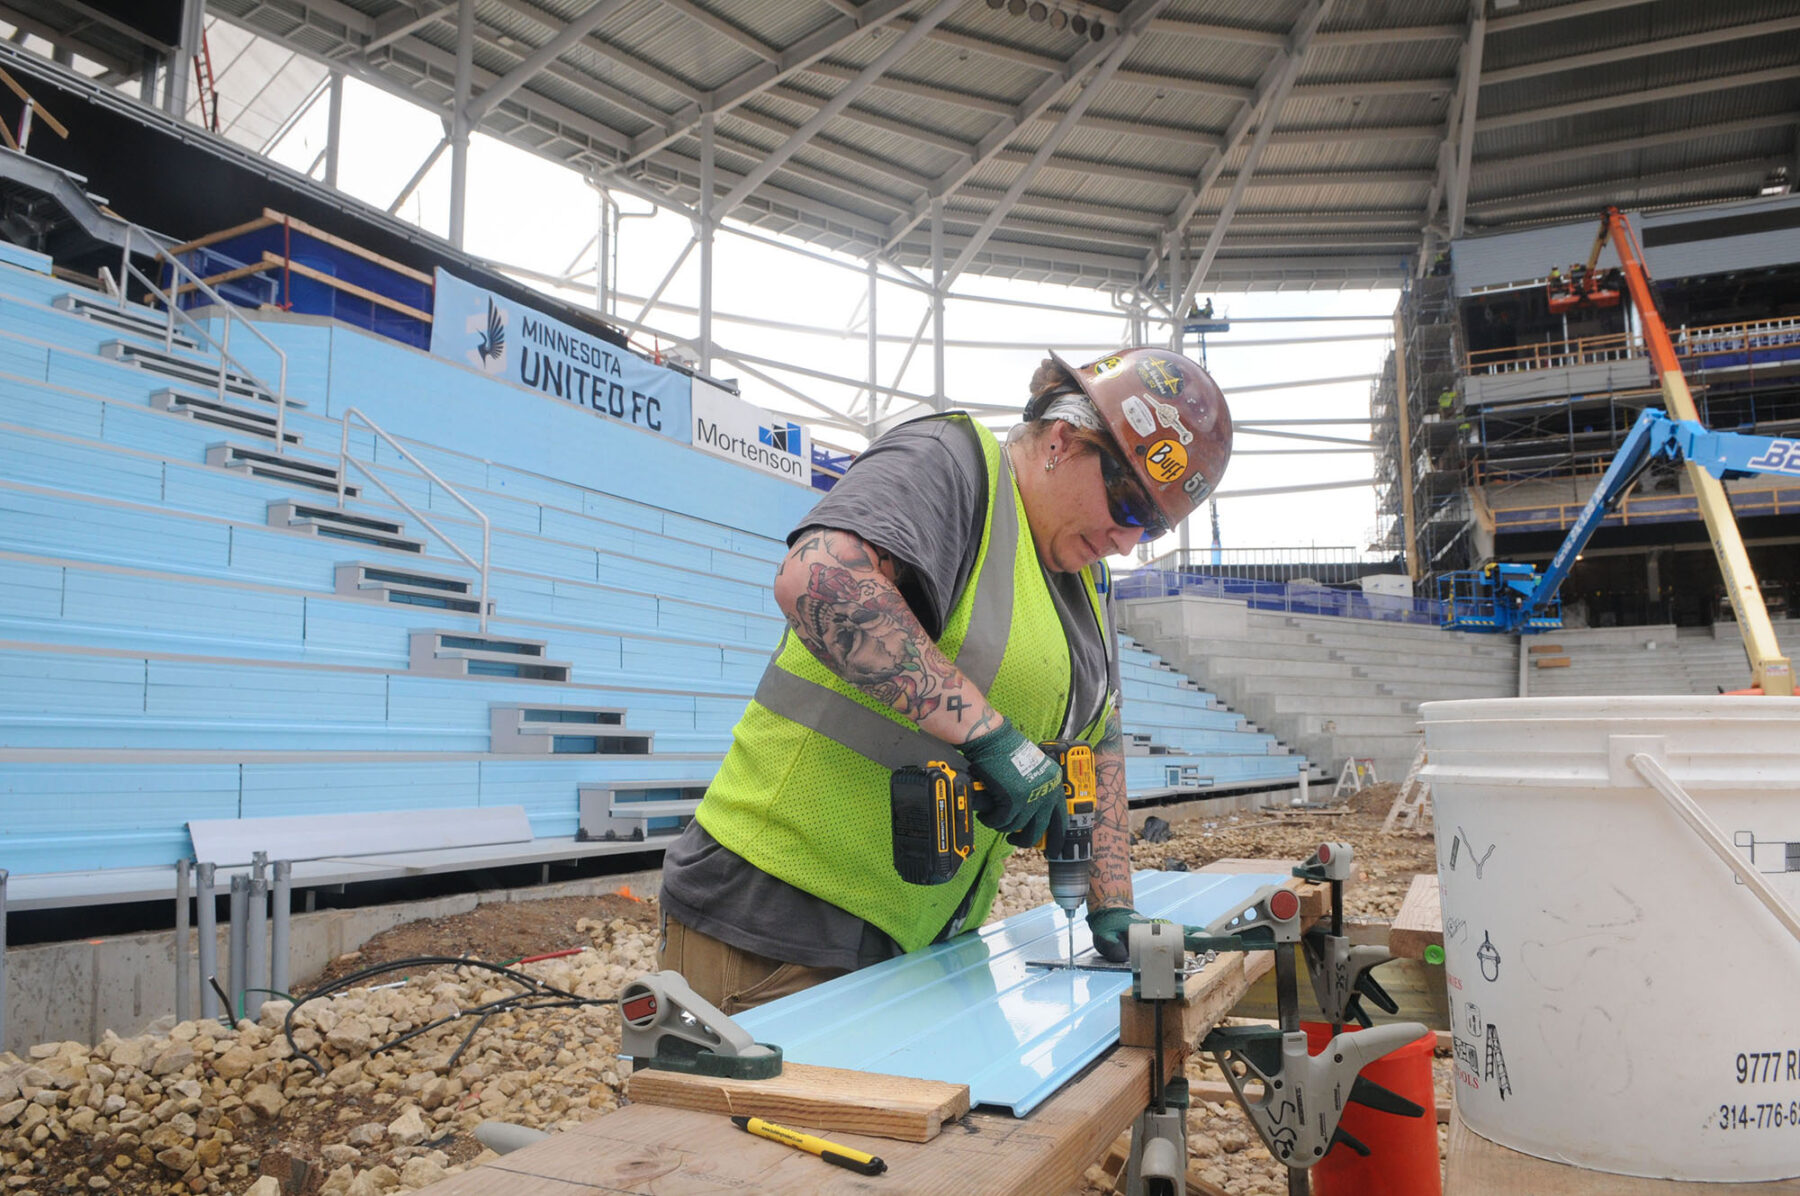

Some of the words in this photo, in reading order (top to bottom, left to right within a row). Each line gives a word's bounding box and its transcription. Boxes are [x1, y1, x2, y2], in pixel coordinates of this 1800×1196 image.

[521, 315, 622, 378] MINNESOTA
[519, 345, 625, 419] UNITED
[631, 390, 662, 432] FC
[696, 417, 803, 478] Mortenson
[1736, 1052, 1782, 1084] 9777
[1719, 1100, 1800, 1130] 314-776-6
